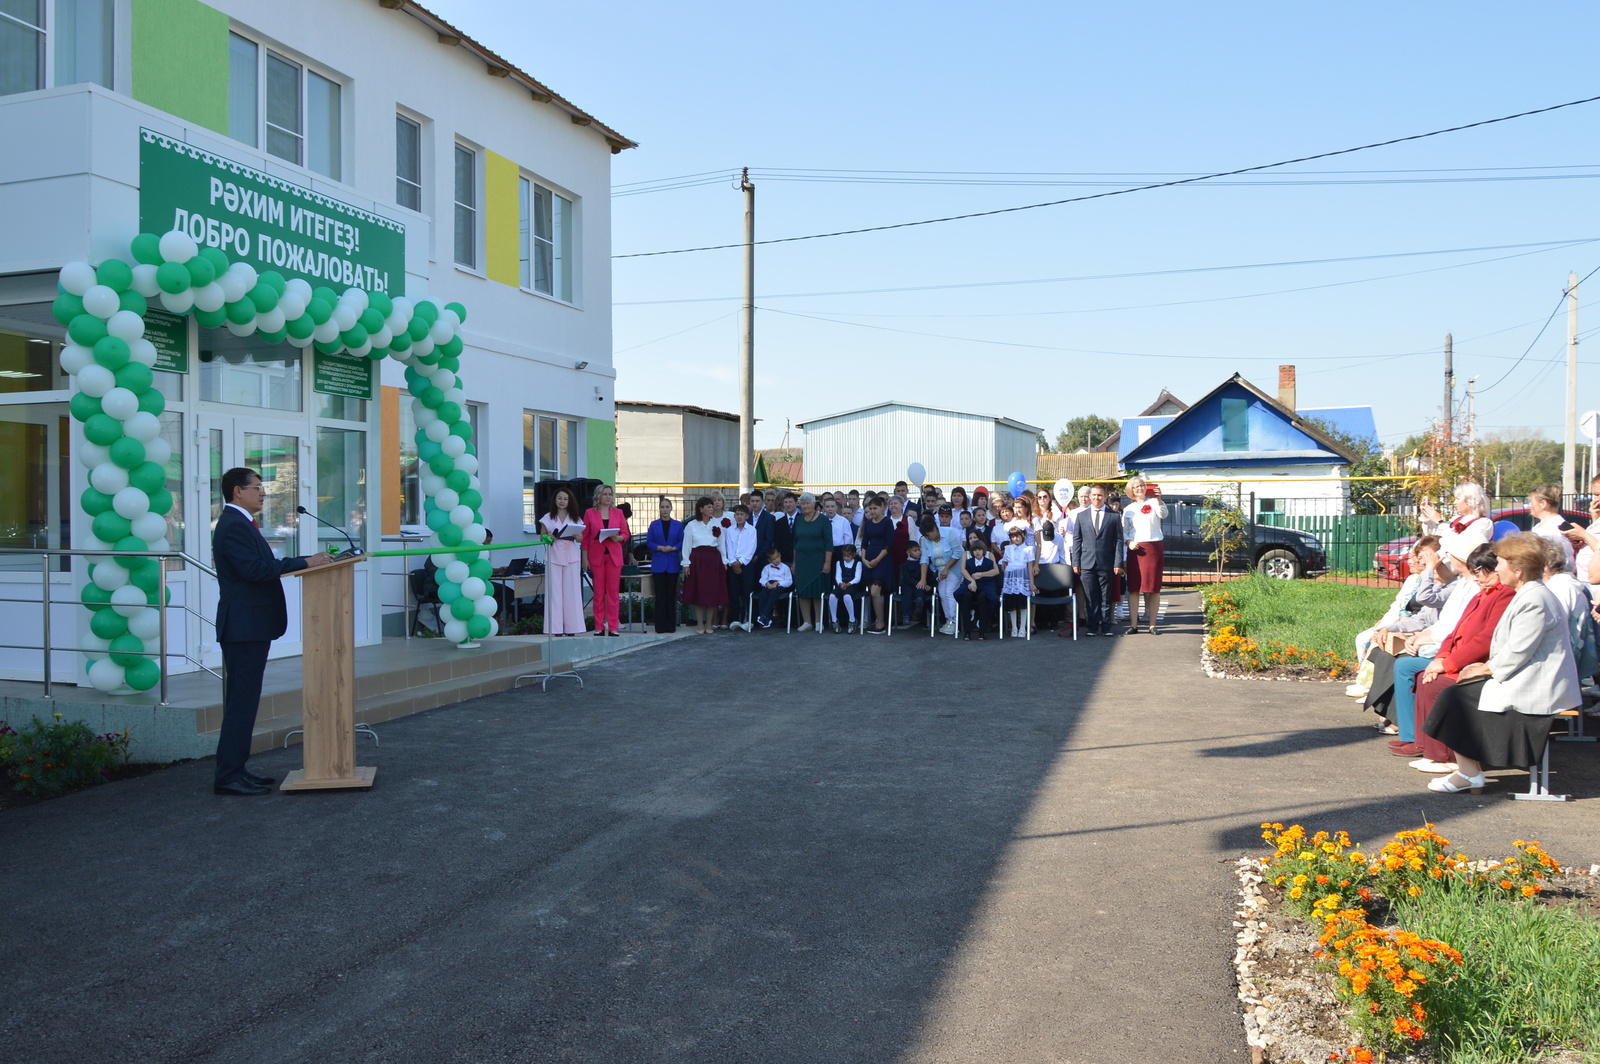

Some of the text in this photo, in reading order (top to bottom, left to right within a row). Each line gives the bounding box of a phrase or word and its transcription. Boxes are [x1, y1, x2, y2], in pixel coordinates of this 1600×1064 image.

[173, 207, 389, 295] ДОБРО ПОЖАЛОВАТЬ!
[210, 176, 360, 256] РӘХИМ ИТЕГЕҘ!
